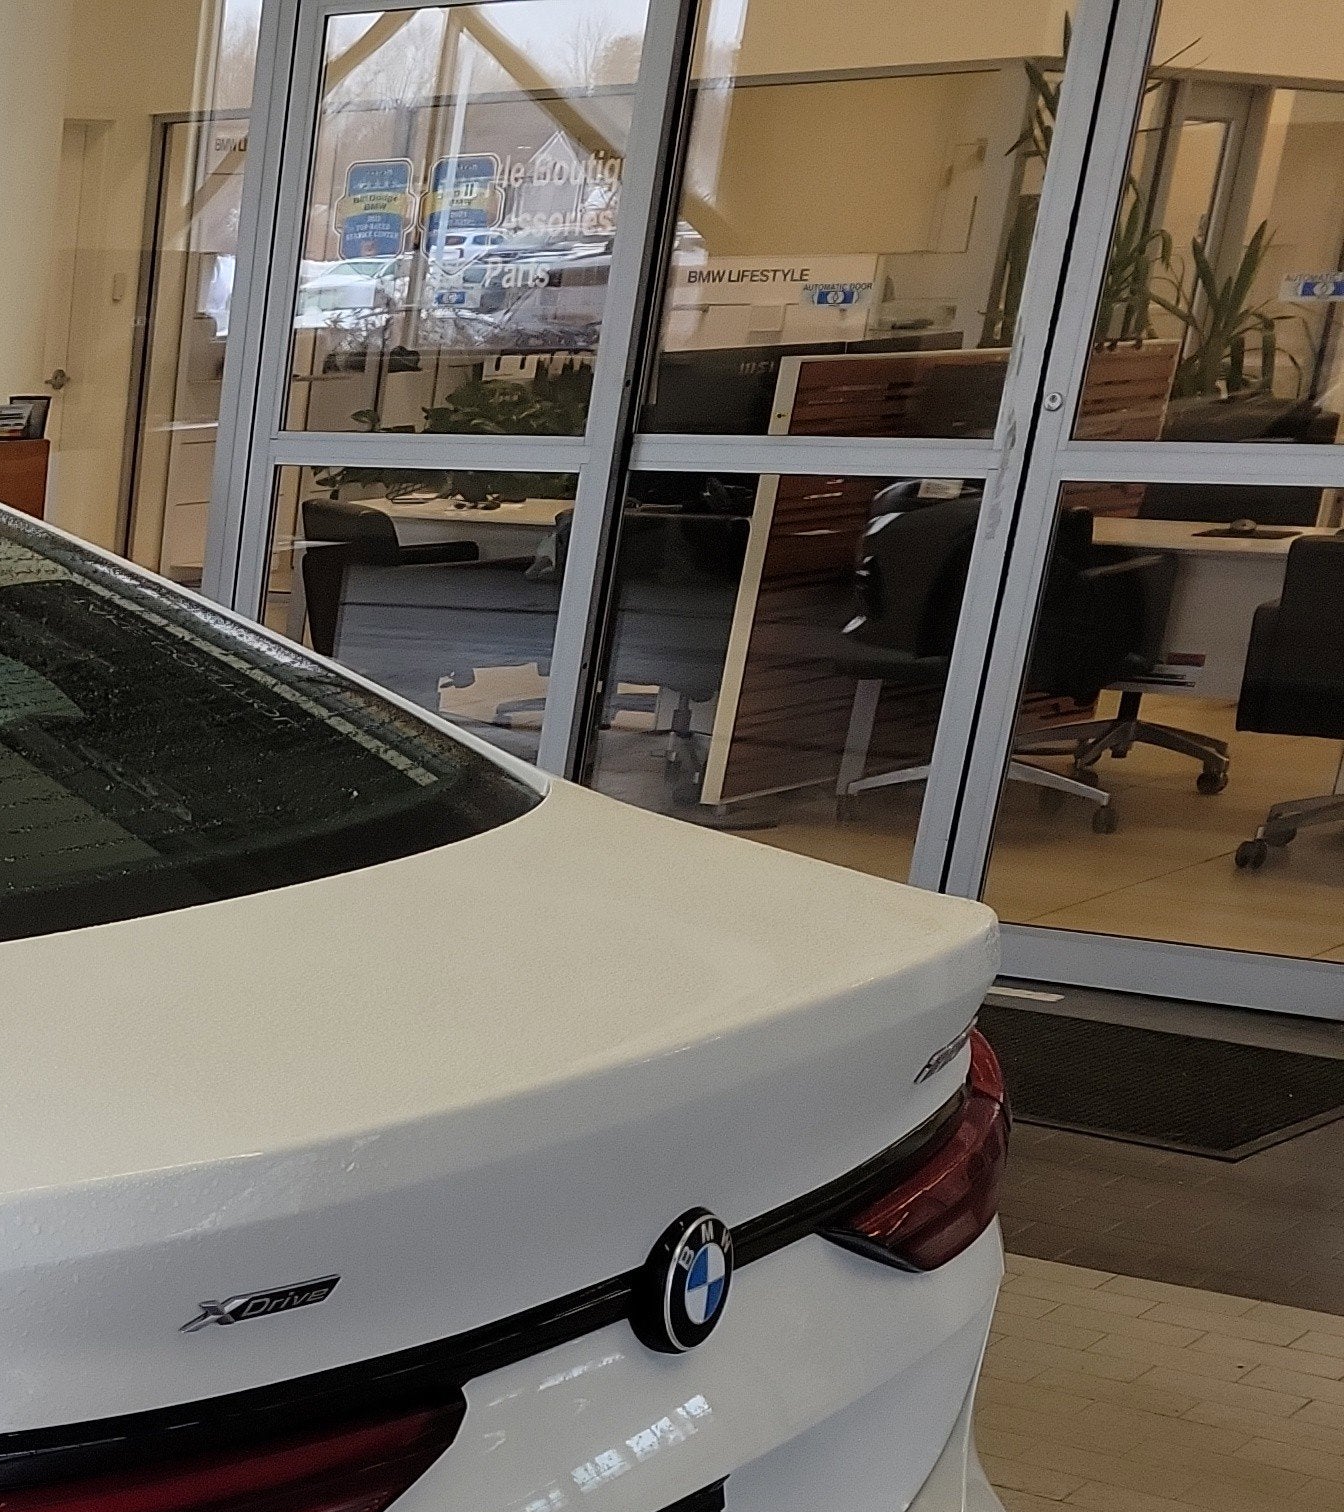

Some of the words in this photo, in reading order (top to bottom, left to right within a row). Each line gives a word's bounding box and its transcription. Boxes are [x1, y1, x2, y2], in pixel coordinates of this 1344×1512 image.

[483, 257, 551, 289] Parts
[687, 270, 728, 284] BMW
[728, 268, 811, 283] LIFESTYLE
[803, 283, 848, 292] AUTOMATIC
[849, 282, 873, 291] DOOR
[677, 1220, 732, 1271] BMW
